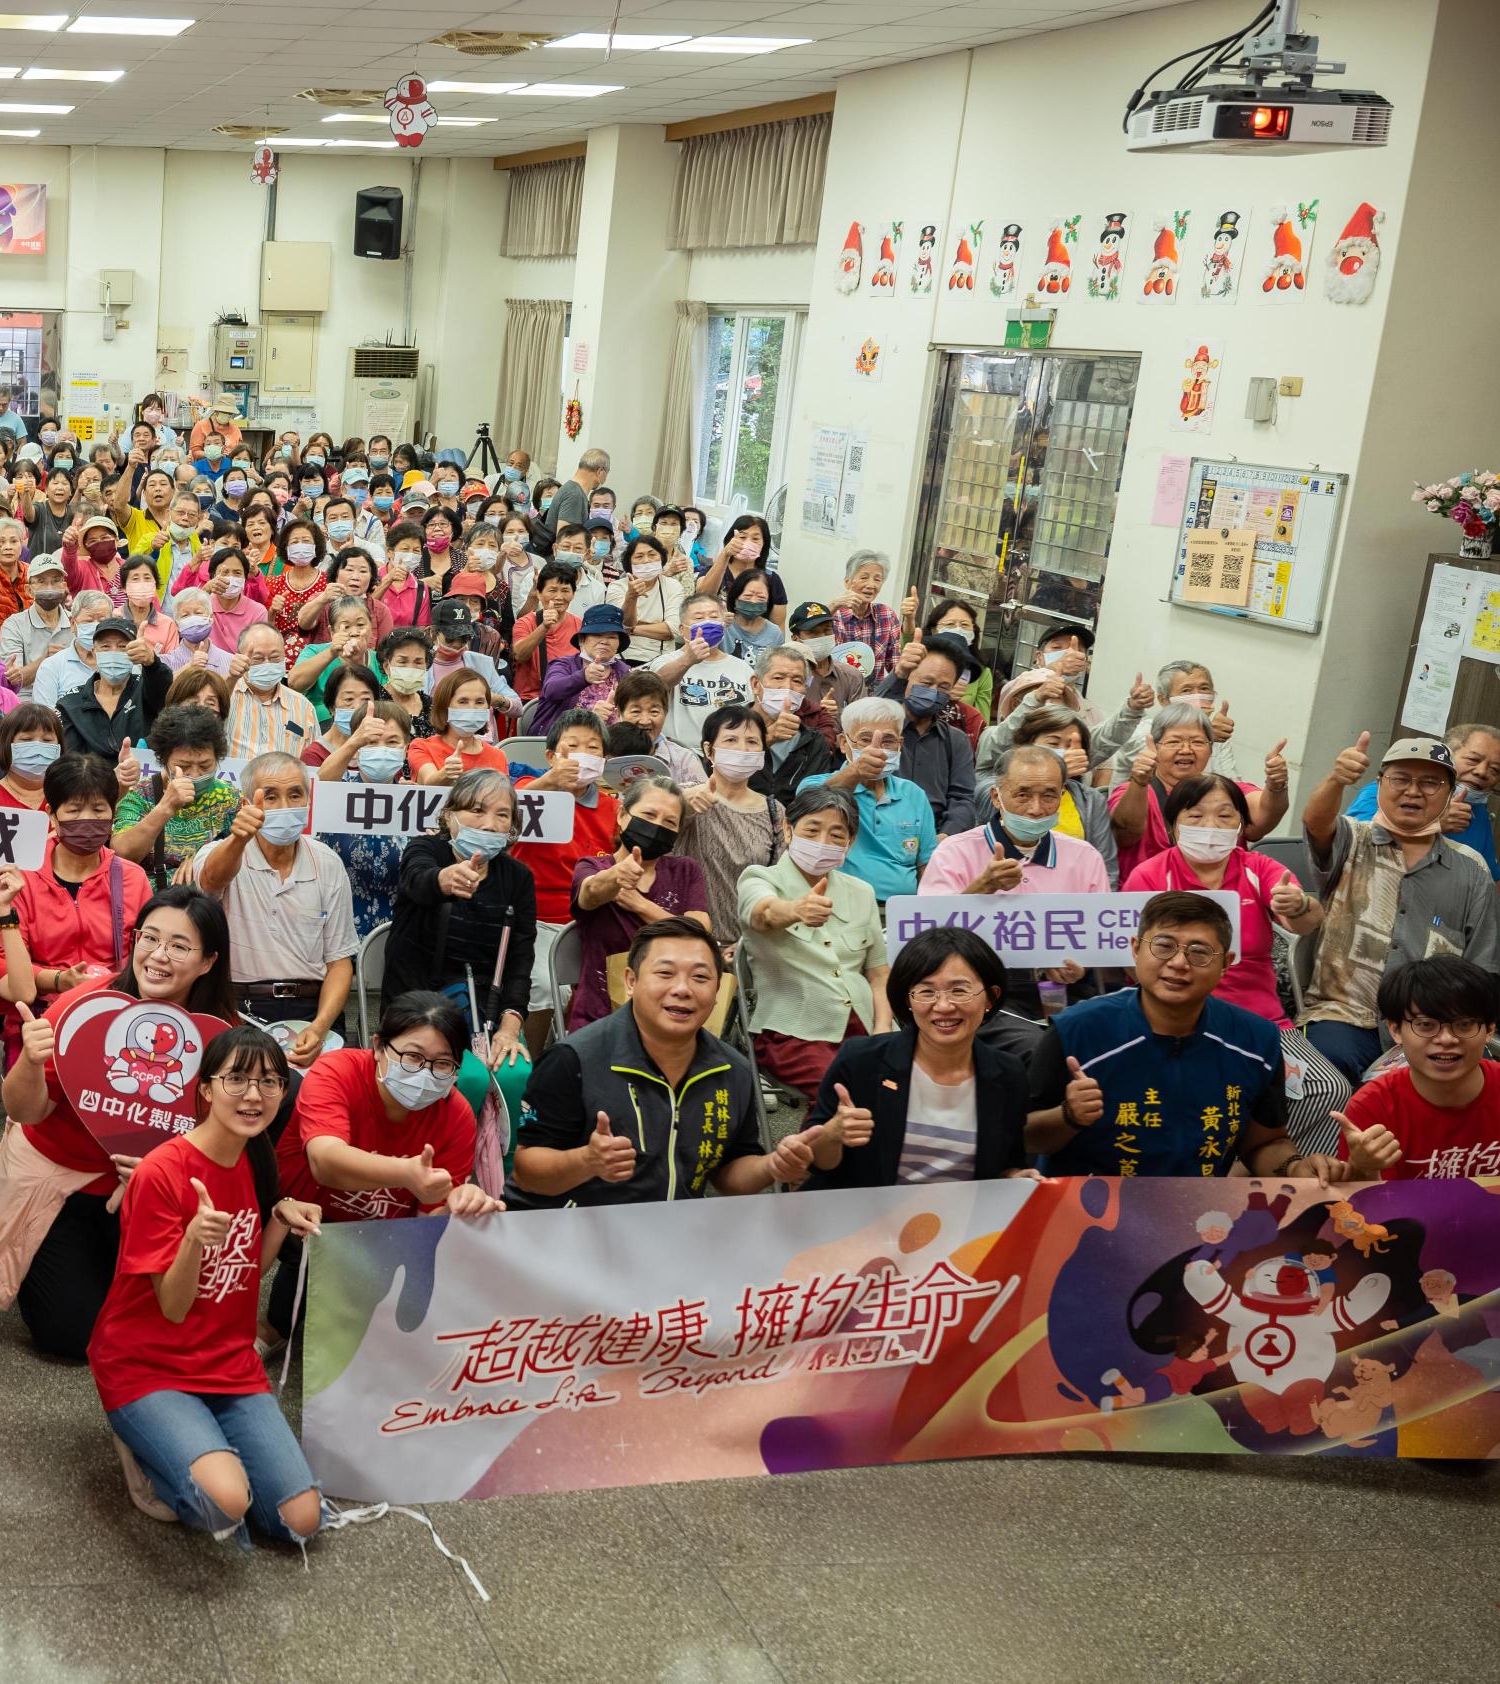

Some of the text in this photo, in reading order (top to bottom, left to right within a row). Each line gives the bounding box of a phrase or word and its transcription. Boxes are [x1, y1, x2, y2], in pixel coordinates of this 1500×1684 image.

[1311, 120, 1334, 128] EPSON
[682, 677, 747, 692] LADDIN
[346, 787, 545, 838] 中化成
[131, 1071, 162, 1084] CCPG
[101, 1097, 197, 1135] 中化製藥
[1143, 1088, 1163, 1128] 主任
[1405, 1141, 1500, 1179] 擁抱
[197, 1247, 258, 1303] 生命
[437, 1261, 999, 1392] 超越健康 擁抱生命
[381, 1397, 528, 1433] Embrace
[536, 1375, 617, 1409] Life
[639, 1362, 777, 1396] Beyond
